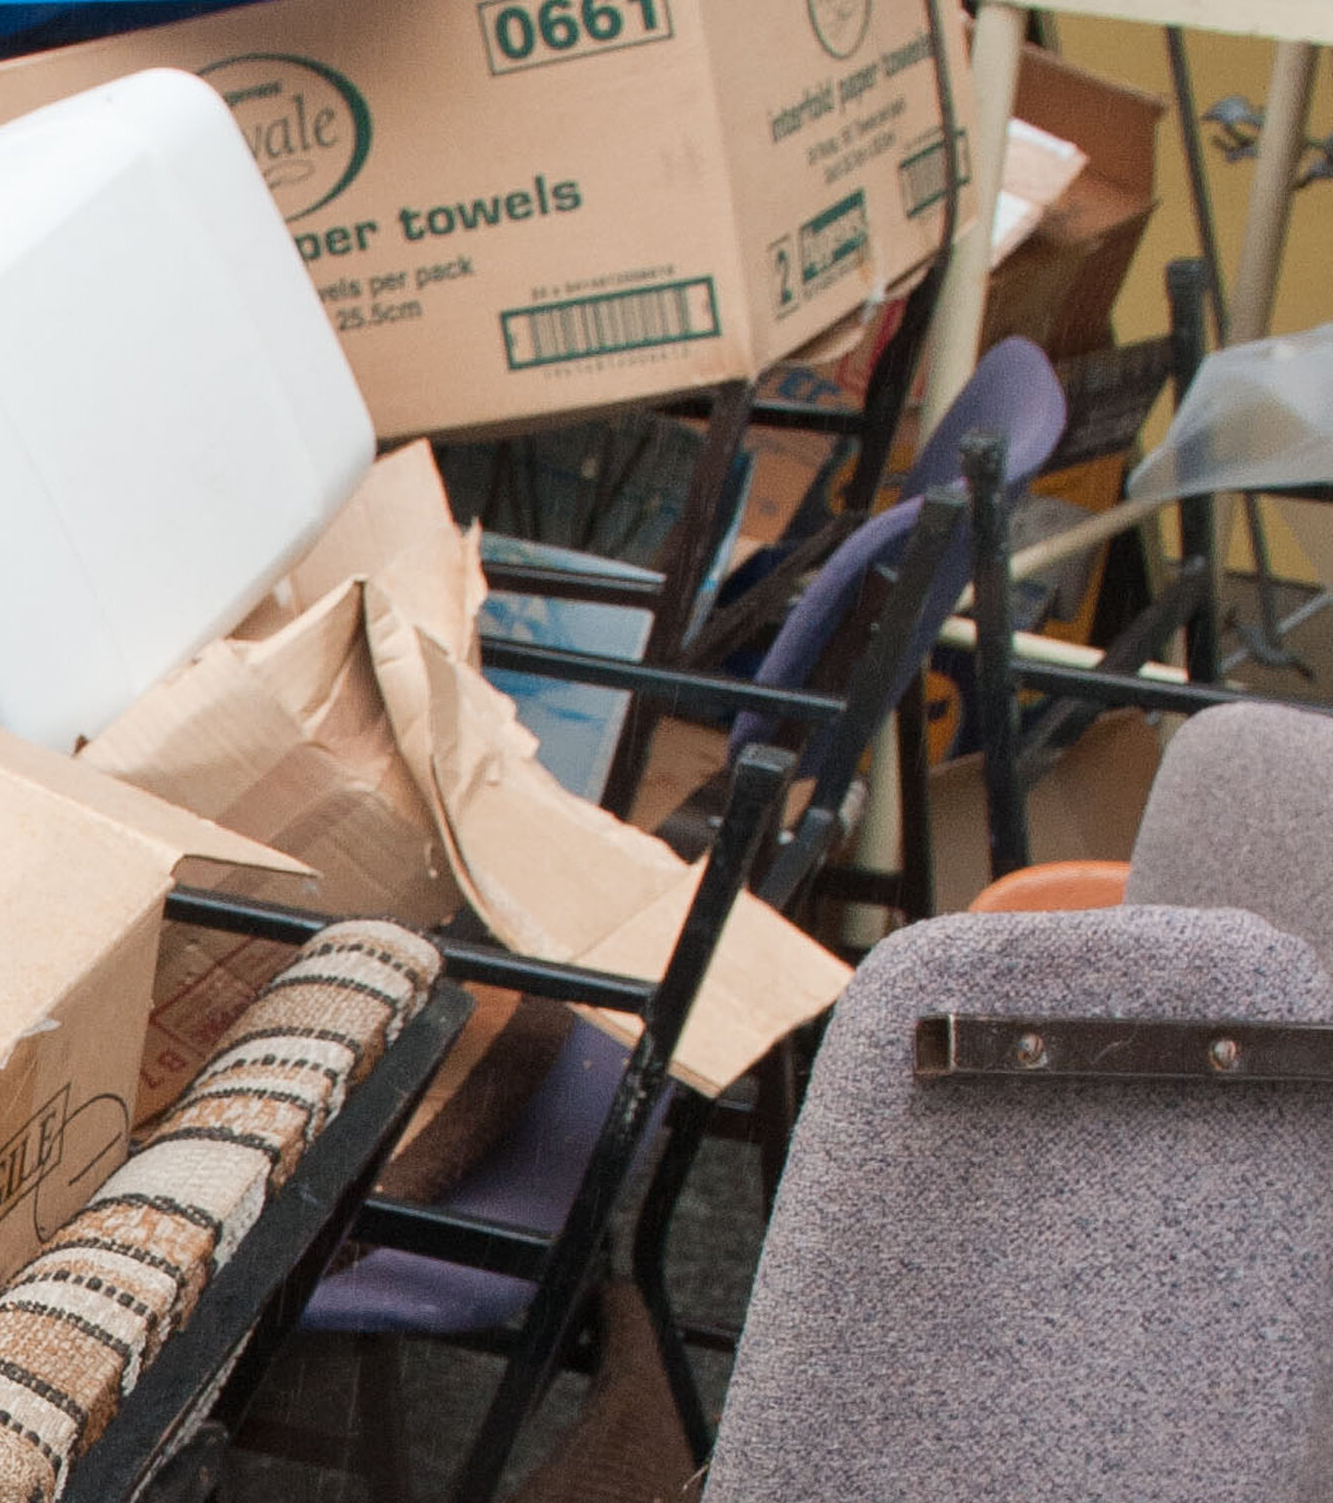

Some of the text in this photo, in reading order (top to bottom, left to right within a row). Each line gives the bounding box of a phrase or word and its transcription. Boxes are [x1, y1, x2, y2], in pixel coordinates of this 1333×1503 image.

[294, 175, 584, 267] per towels
[370, 271, 408, 297] per
[416, 254, 474, 290] pack
